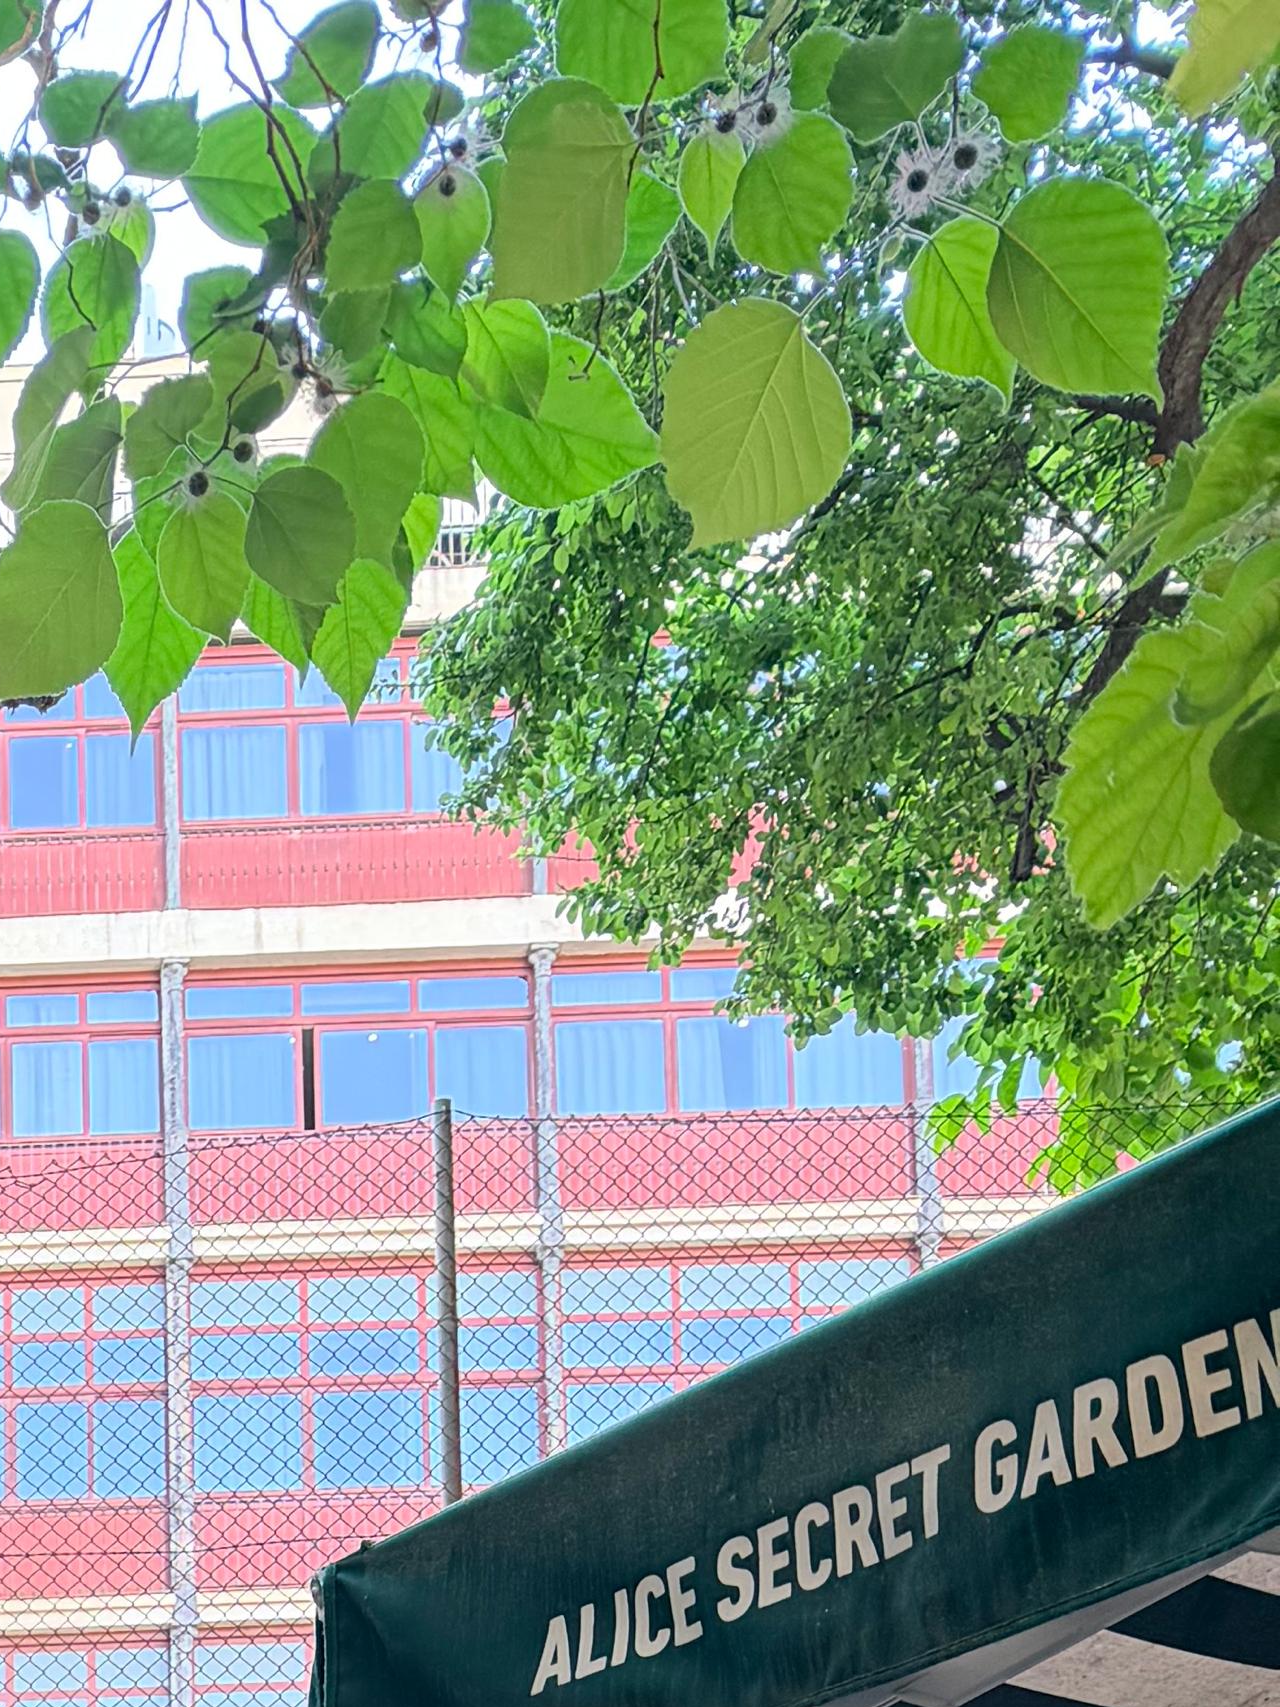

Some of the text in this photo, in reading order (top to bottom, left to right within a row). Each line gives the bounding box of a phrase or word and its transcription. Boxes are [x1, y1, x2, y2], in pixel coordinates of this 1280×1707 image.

[529, 1306, 1280, 1697] ALICE SECRET GARDEN
